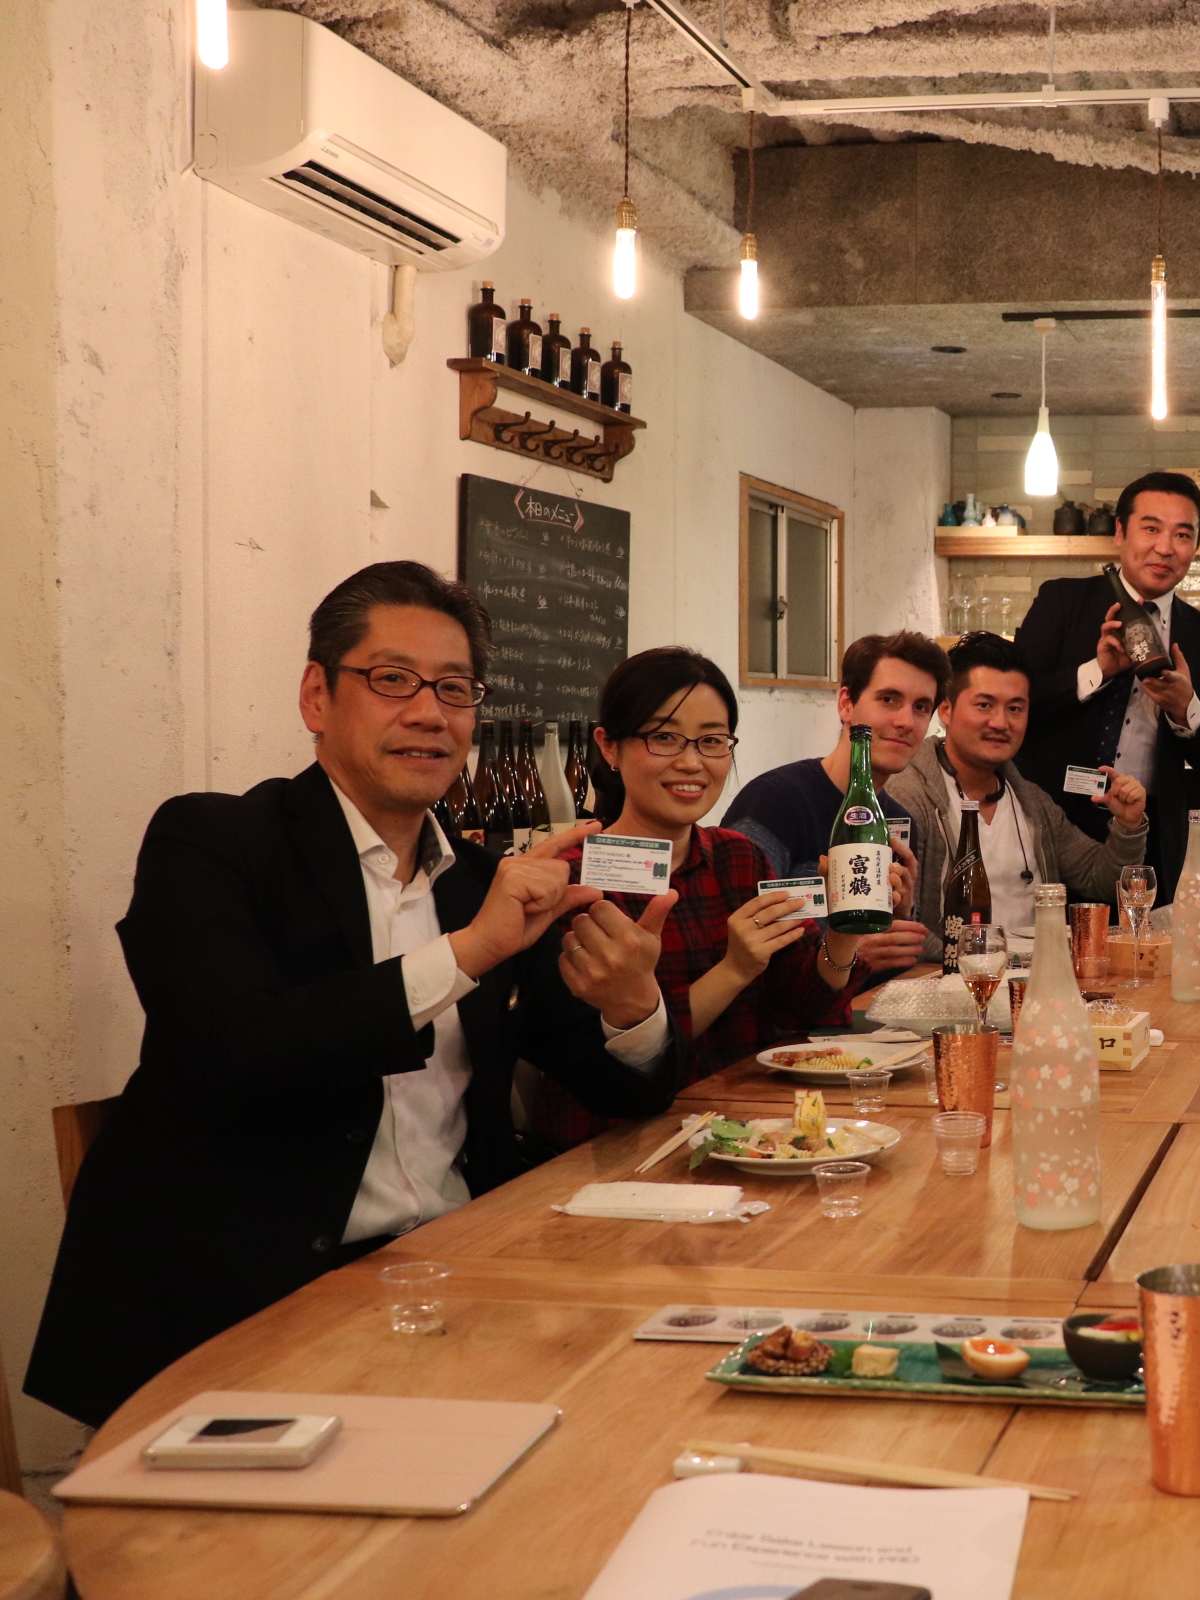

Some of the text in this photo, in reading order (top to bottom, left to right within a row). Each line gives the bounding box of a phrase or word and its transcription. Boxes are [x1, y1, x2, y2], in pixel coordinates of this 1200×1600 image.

[848, 854, 872, 896] 富鶴
[808, 1539, 872, 1553] Lesson
[877, 1545, 913, 1554] and
